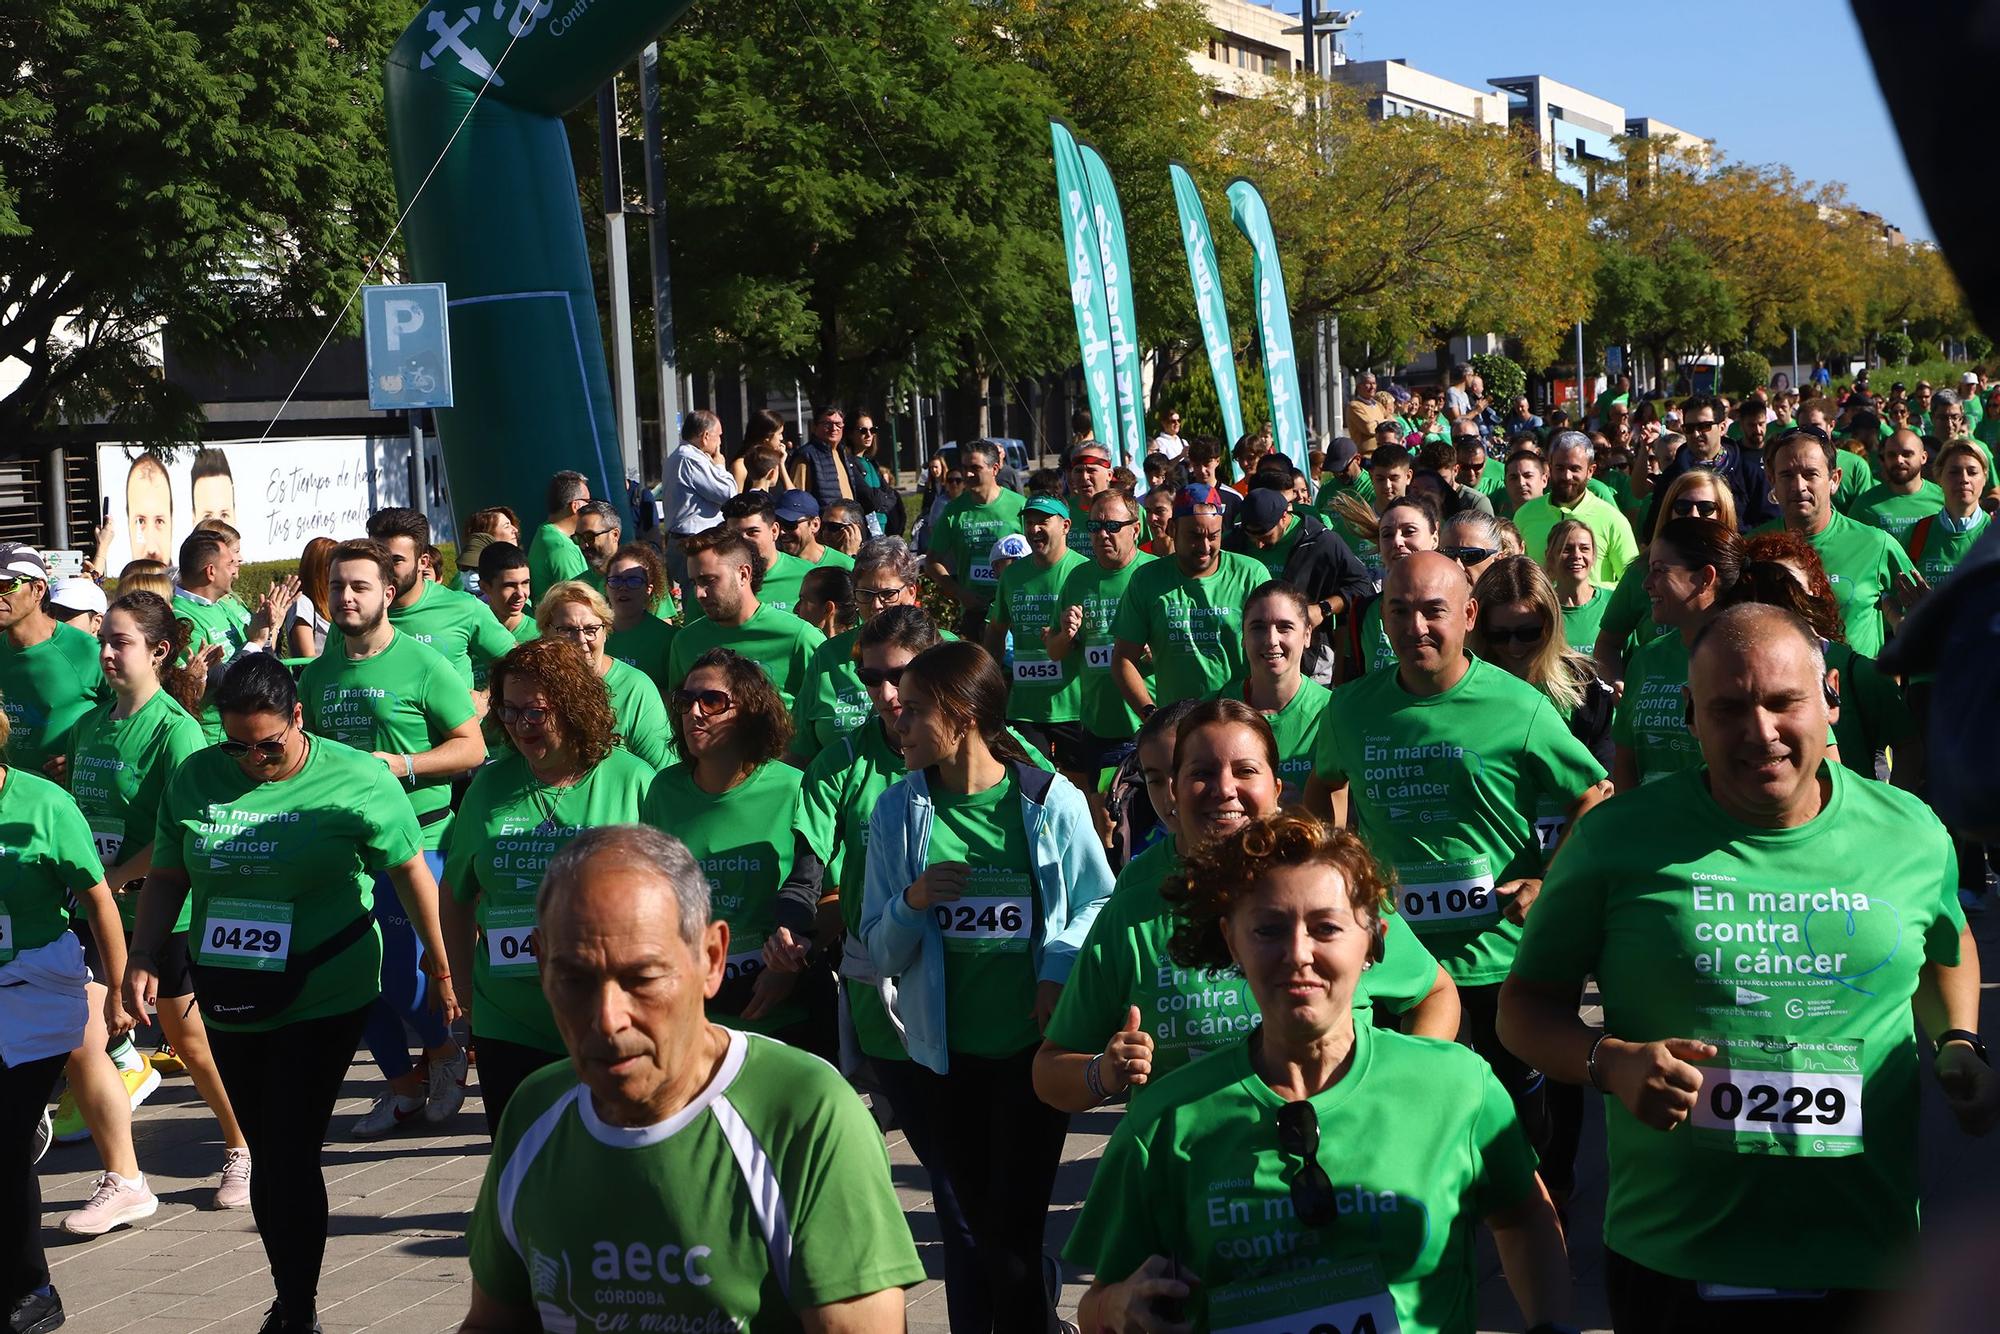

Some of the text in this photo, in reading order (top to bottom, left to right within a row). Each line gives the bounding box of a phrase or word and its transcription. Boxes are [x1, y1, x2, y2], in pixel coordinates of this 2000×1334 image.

[549, 0, 597, 36] Contr
[384, 300, 424, 351] P
[266, 468, 287, 503] Es
[336, 460, 349, 486] de
[354, 457, 384, 489] hacer
[974, 568, 995, 579] 026
[1013, 593, 1058, 602] En marcha
[1083, 598, 1120, 608] En mar
[1012, 604, 1040, 612] contra
[1084, 608, 1116, 618] contra
[1168, 605, 1229, 617] En marcha
[1020, 612, 1050, 621] cáncer
[1168, 619, 1204, 629] contra
[1086, 621, 1093, 629] el
[1169, 632, 1180, 641] el
[1090, 650, 1109, 664] 01
[1018, 664, 1058, 677] 0453
[324, 687, 384, 701] En marcha
[1641, 682, 1656, 695] En
[837, 694, 852, 704] En
[1636, 698, 1677, 710] contra
[322, 701, 359, 714] contra
[322, 716, 332, 728] el
[834, 716, 845, 727] el
[1645, 712, 1688, 728] cánce
[1364, 741, 1464, 762] En marcha
[74, 753, 124, 772] En marcha
[1364, 763, 1424, 780] contra
[75, 784, 108, 799] cáncer
[1366, 782, 1450, 800] el cáncer
[207, 804, 300, 823] En marcha
[200, 822, 256, 838] contra
[500, 824, 524, 837] En
[195, 836, 280, 852] el cáncer
[496, 840, 555, 852] contra
[493, 854, 548, 870] el cán
[1692, 872, 1737, 882] Córdoba
[712, 893, 745, 908] ncer
[1404, 886, 1488, 916] 0106
[1693, 886, 1870, 912] En marcha
[935, 905, 1022, 932] 0246
[212, 926, 282, 952] 0429
[1695, 919, 1800, 943] contra
[500, 935, 538, 960] 04
[1695, 948, 1848, 974] el cáncer
[1157, 966, 1188, 988] En
[1156, 988, 1238, 1013] contra
[1157, 1012, 1263, 1040] el cánce
[1738, 1039, 1749, 1047] En
[1826, 1043, 1858, 1052] Cáncer
[1710, 1082, 1846, 1125] 0229
[1207, 1184, 1399, 1227] En mcha
[1216, 1228, 1320, 1259] contra
[591, 1240, 712, 1286] aecc
[594, 1287, 666, 1305] CÓRDOBA
[595, 1309, 748, 1334] en marcha
